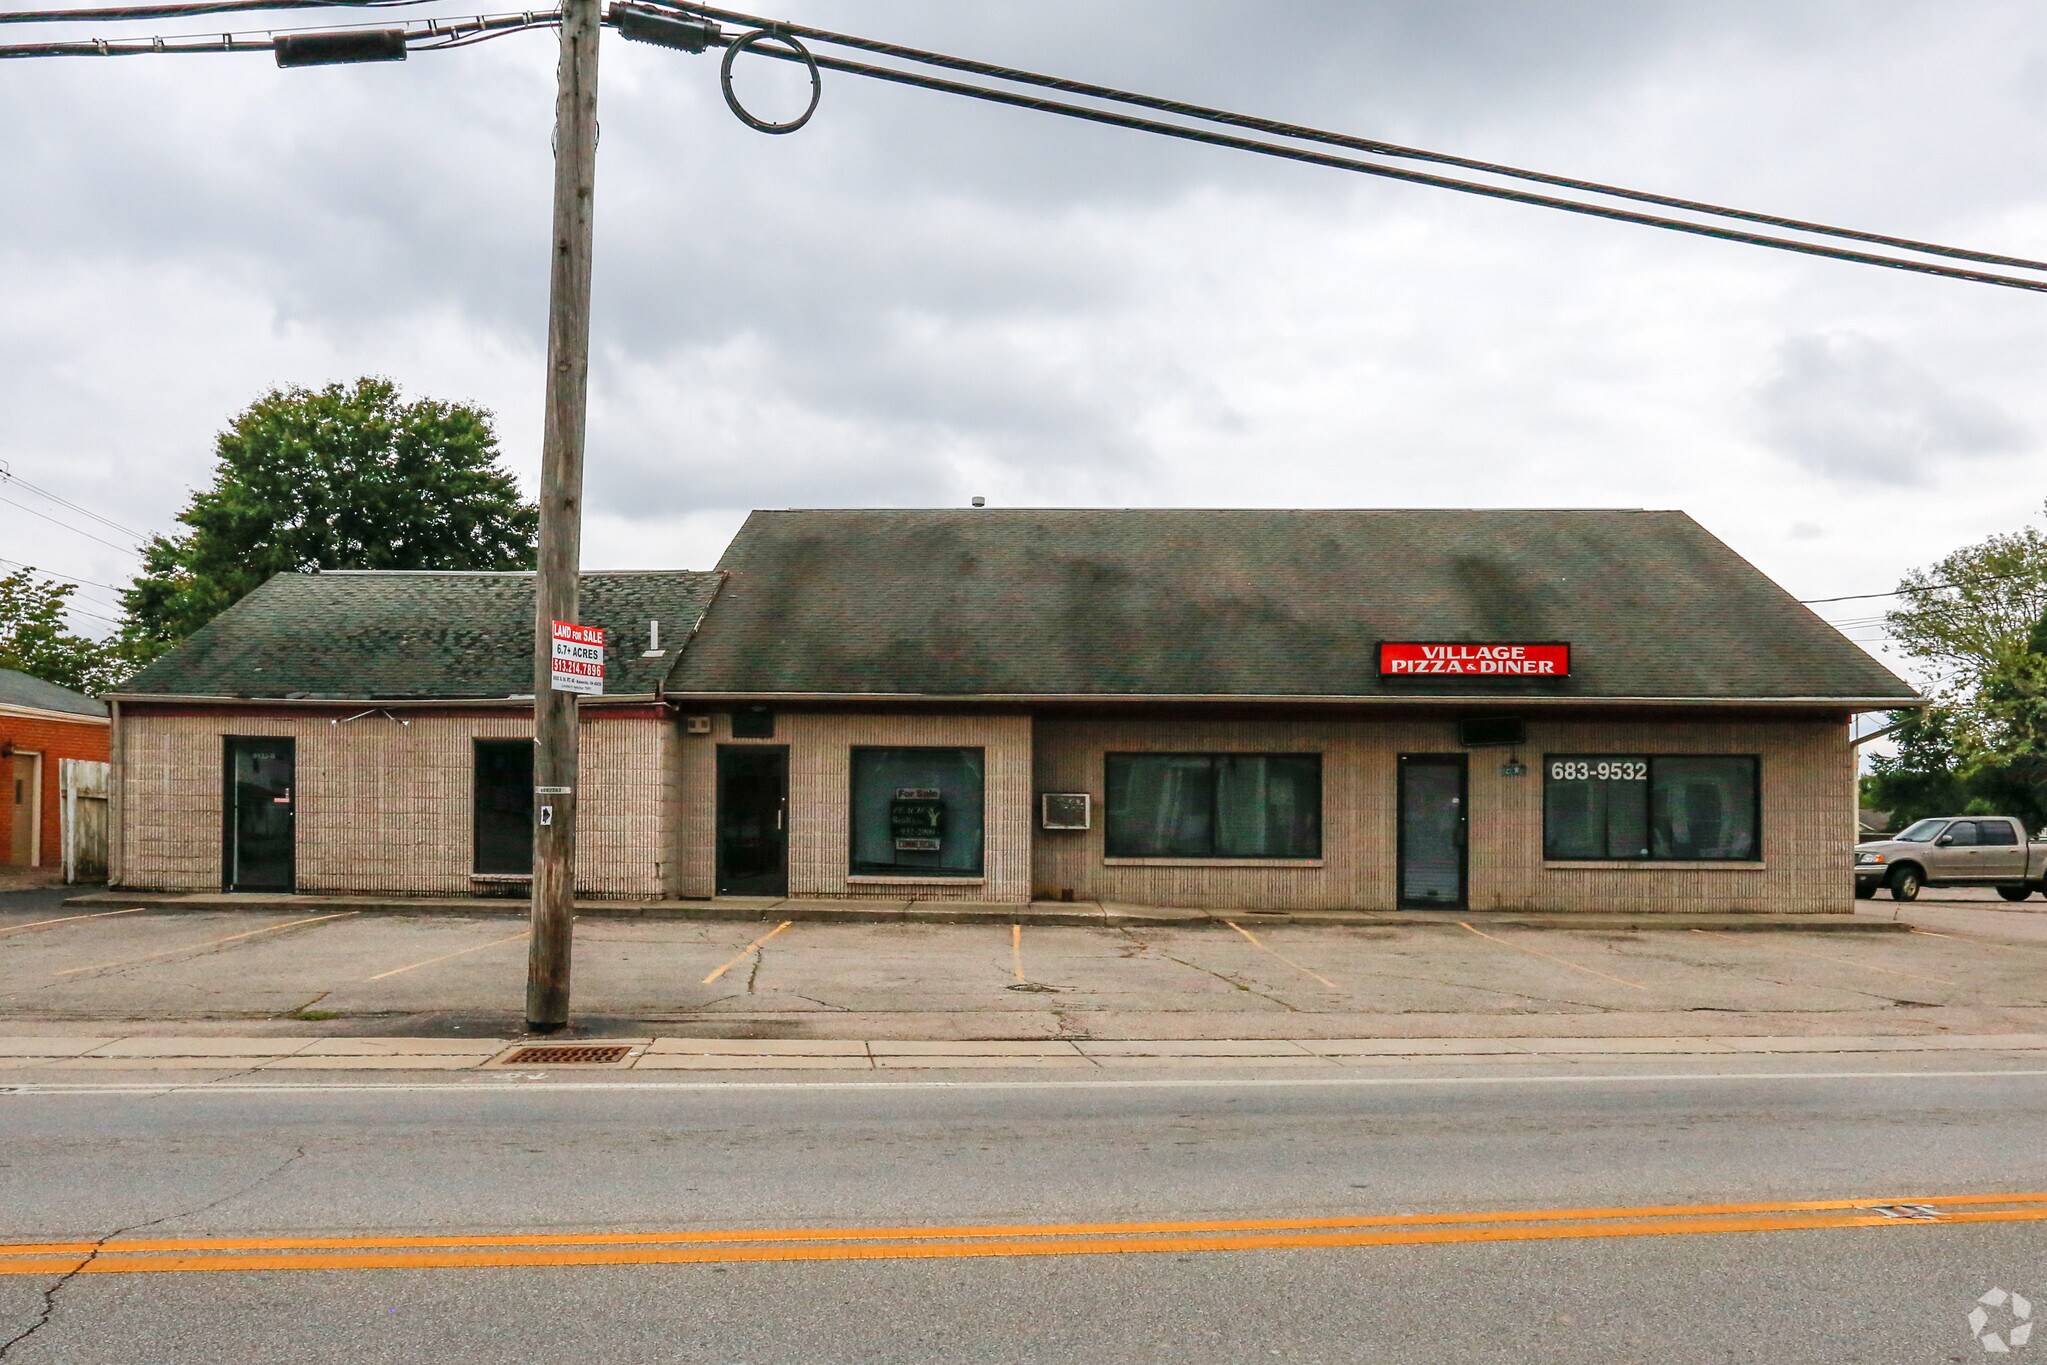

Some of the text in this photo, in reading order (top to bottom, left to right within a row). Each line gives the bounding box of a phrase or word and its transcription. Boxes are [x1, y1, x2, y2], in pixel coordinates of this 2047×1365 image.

[554, 623, 602, 644] LAND FOR SALE
[556, 643, 598, 660] 6.7+ ACRES
[1421, 646, 1525, 660] VILLAGE
[554, 658, 601, 677] 513.214.7896
[1391, 660, 1554, 673] PIZZA & DINER
[1551, 762, 1647, 780] 683-9532
[898, 789, 938, 798] For Sale
